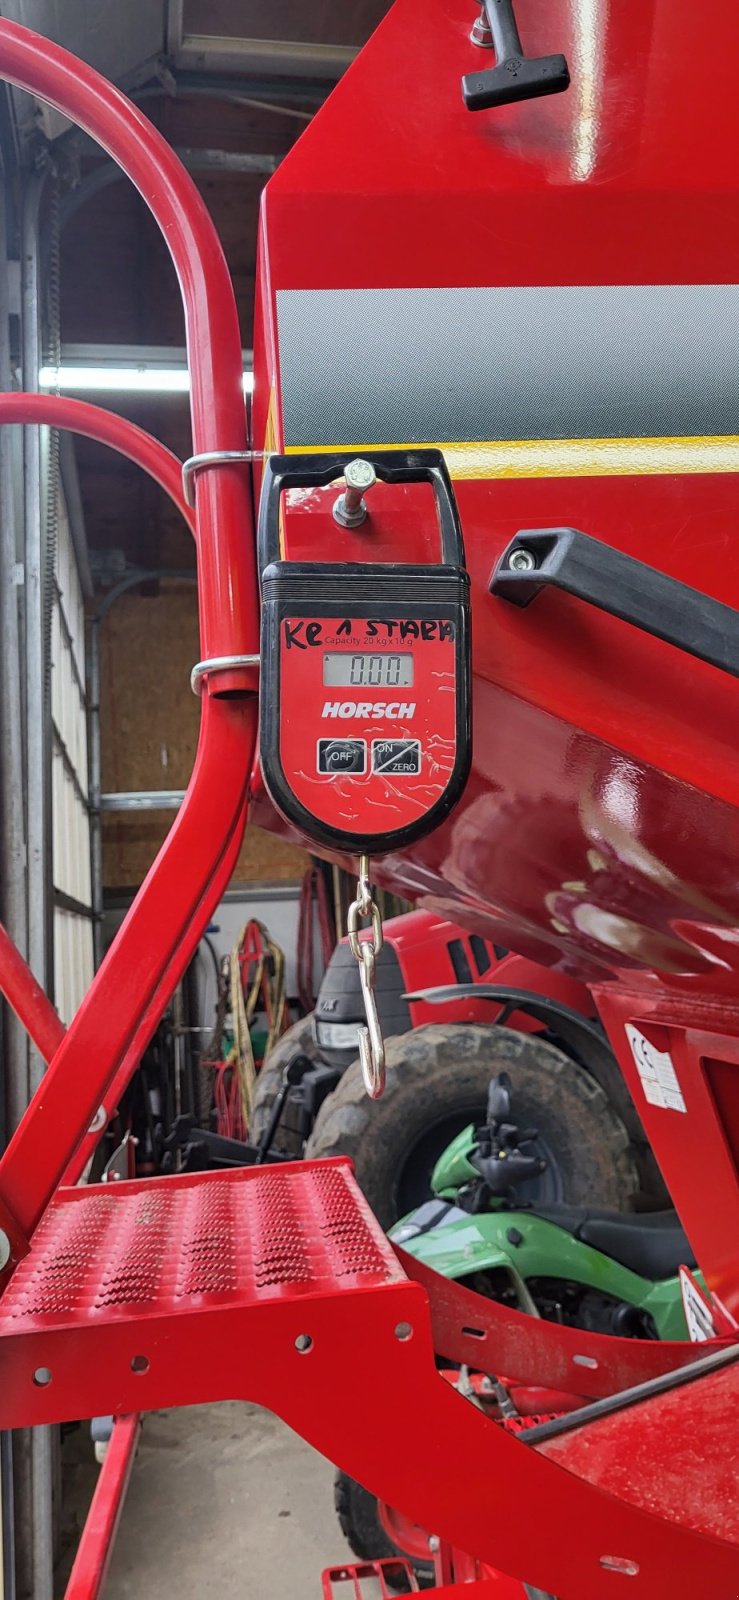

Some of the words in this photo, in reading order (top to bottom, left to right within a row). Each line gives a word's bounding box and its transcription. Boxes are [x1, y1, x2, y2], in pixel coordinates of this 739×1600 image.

[325, 636, 361, 646] Capacity
[364, 636, 374, 645] 20
[376, 636, 387, 647] kg
[395, 636, 405, 645] 10
[407, 638, 413, 647] g
[350, 656, 401, 685] 0.00
[321, 702, 416, 719] HORSCH
[377, 743, 393, 753] ON
[331, 751, 353, 761] OFF
[392, 763, 416, 772] ZERO
